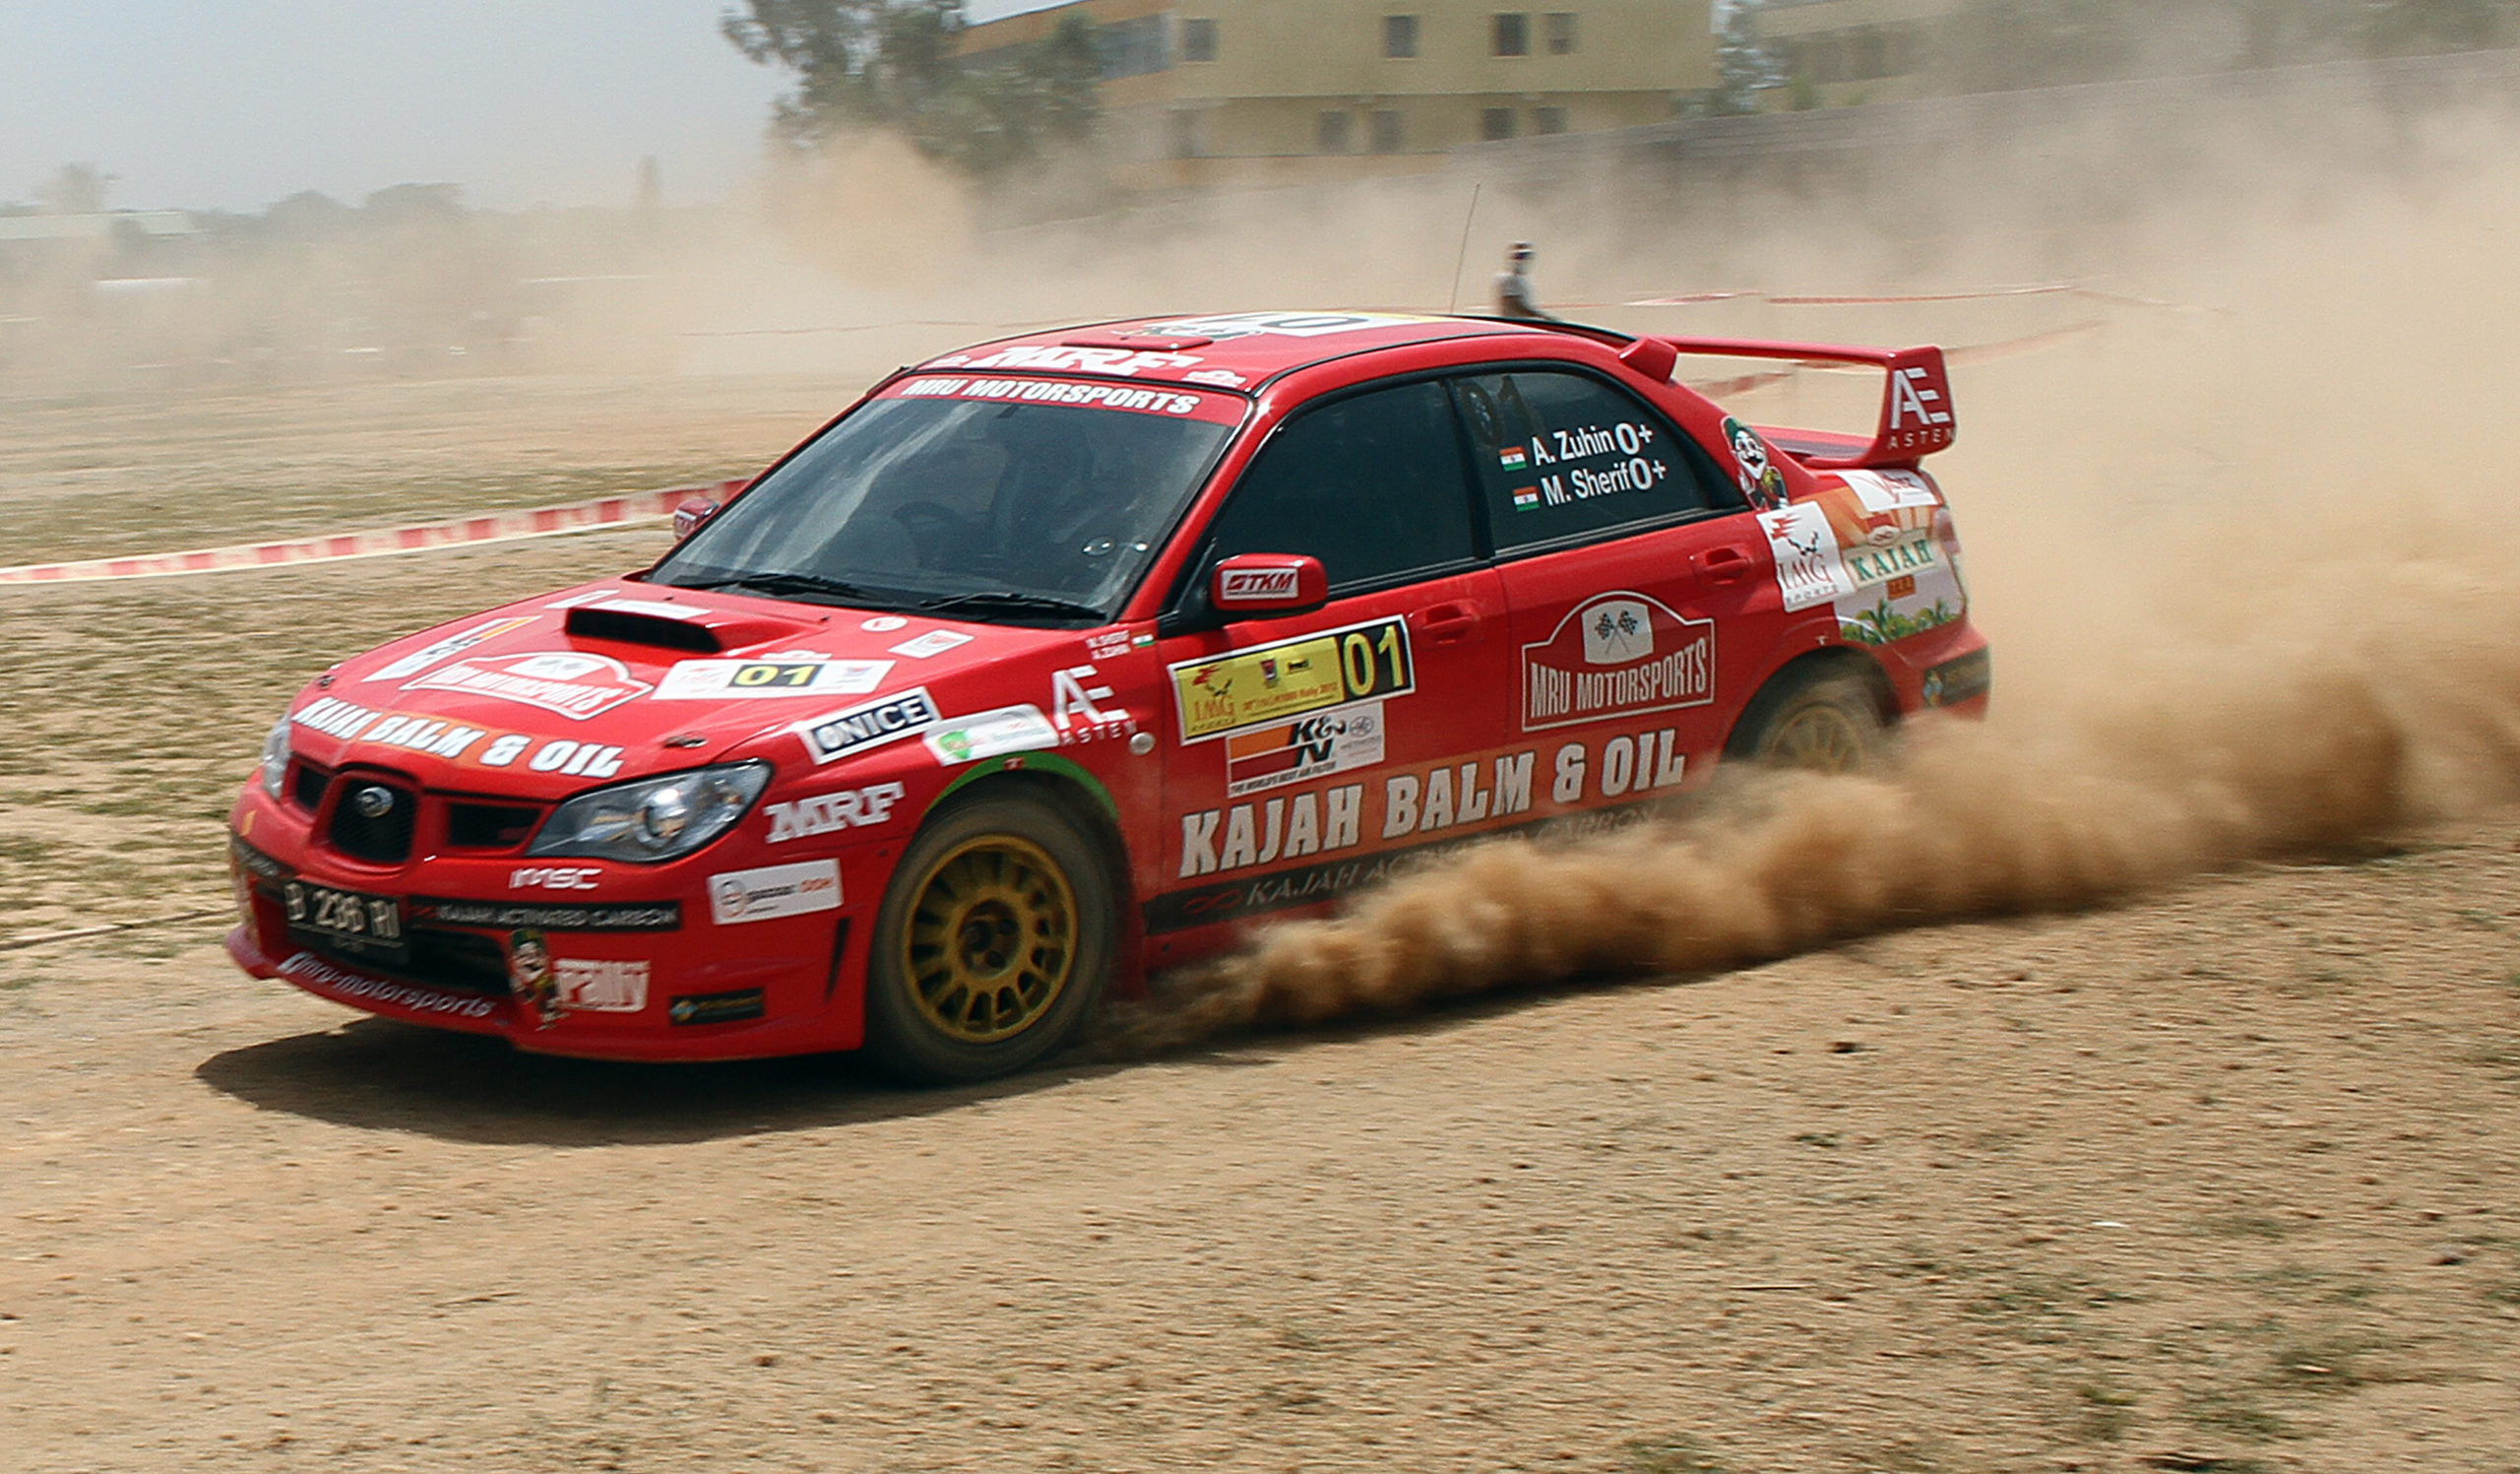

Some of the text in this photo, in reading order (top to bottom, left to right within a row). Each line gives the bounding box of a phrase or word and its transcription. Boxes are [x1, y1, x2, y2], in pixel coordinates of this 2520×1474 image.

[963, 346, 1205, 376] MRF
[901, 379, 1201, 415] MRU MOTORSPORTS
[1531, 436, 1555, 466] A.
[1553, 425, 1615, 460] Zuhin
[1541, 475, 1571, 506] M.
[1571, 462, 1631, 499] Sherif
[1850, 539, 1934, 581] KAJAH
[733, 665, 816, 686] 01
[1343, 624, 1404, 696] 01
[1531, 637, 1707, 719] MRU MOTORSPORTS
[358, 715, 488, 759] BALM
[478, 734, 533, 767] &
[528, 739, 625, 779] OIL
[762, 781, 907, 844] MRF
[1178, 785, 1364, 879] KAJAH
[1382, 751, 1536, 839] BALM
[1552, 742, 1587, 803] &
[1602, 728, 1686, 798] OIL
[1246, 861, 1362, 907] KAJAH
